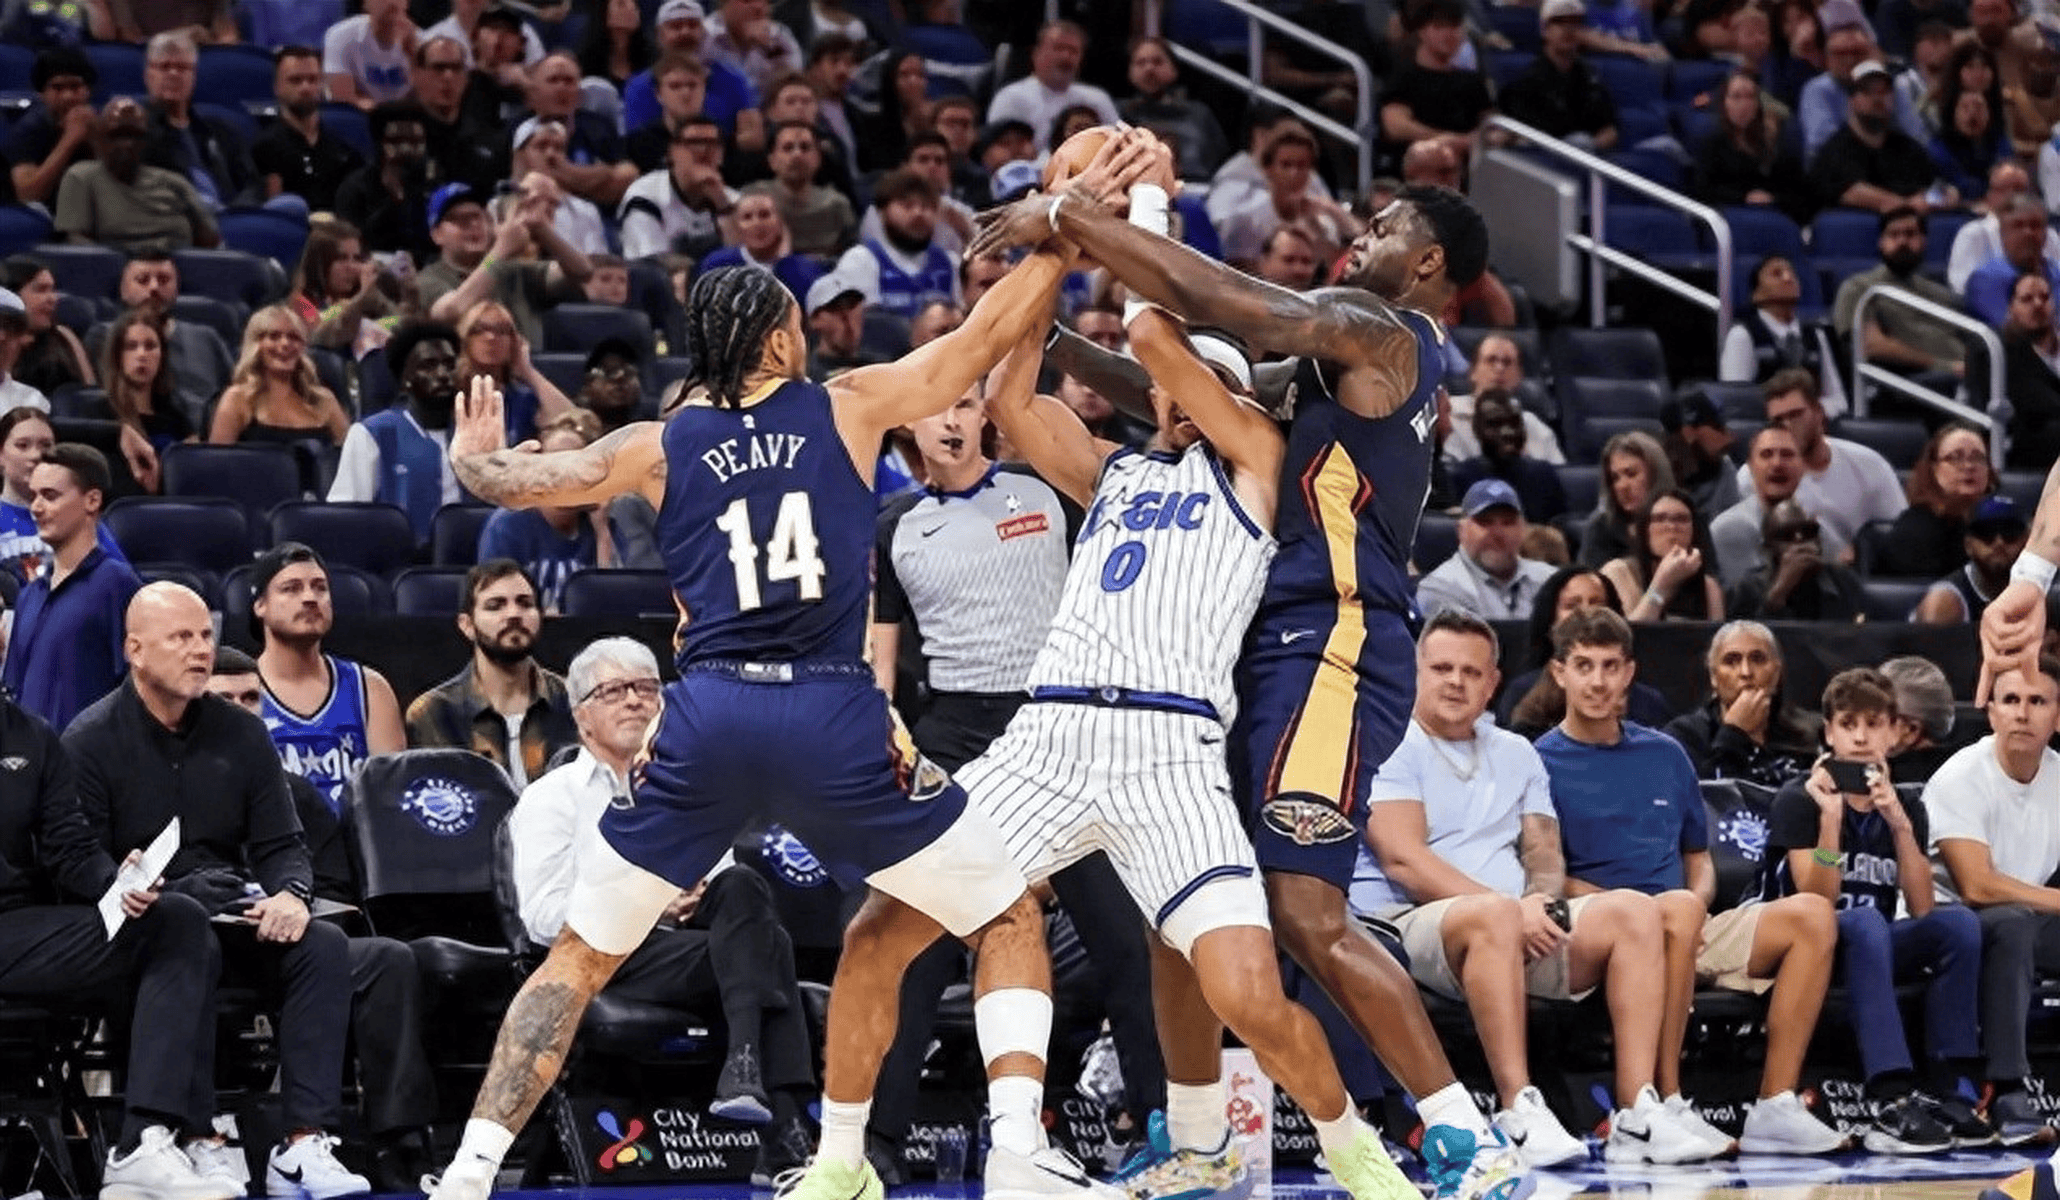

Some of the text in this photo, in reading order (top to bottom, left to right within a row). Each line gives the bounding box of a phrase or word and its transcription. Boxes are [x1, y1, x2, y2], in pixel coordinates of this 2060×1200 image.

[701, 433, 806, 483] PEAVY
[715, 491, 826, 612] 14
[1100, 541, 1146, 592] 0
[653, 1109, 700, 1132] City
[659, 1129, 761, 1148] National
